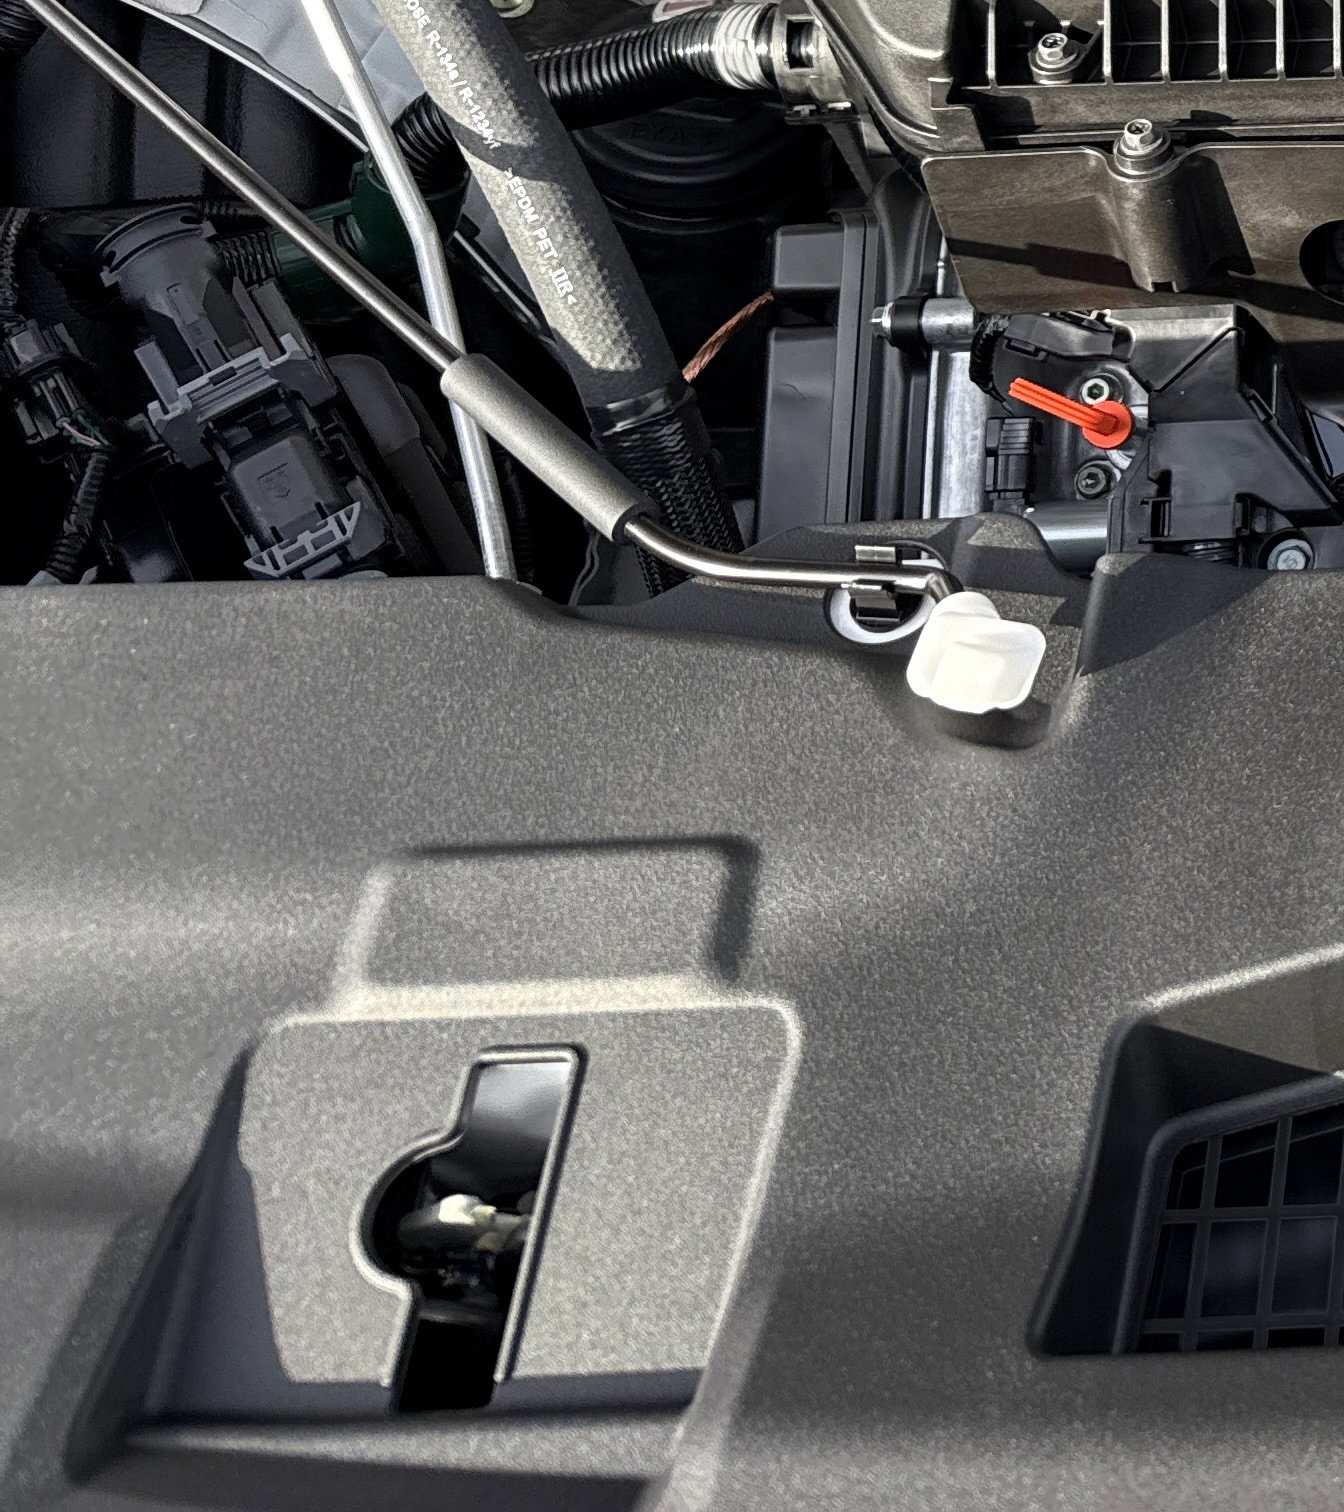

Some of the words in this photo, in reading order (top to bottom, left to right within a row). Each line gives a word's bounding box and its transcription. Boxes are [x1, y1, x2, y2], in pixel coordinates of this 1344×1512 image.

[426, 29, 459, 81] R-134a
[459, 87, 501, 150] R-1234yf
[532, 226, 559, 260] PET
